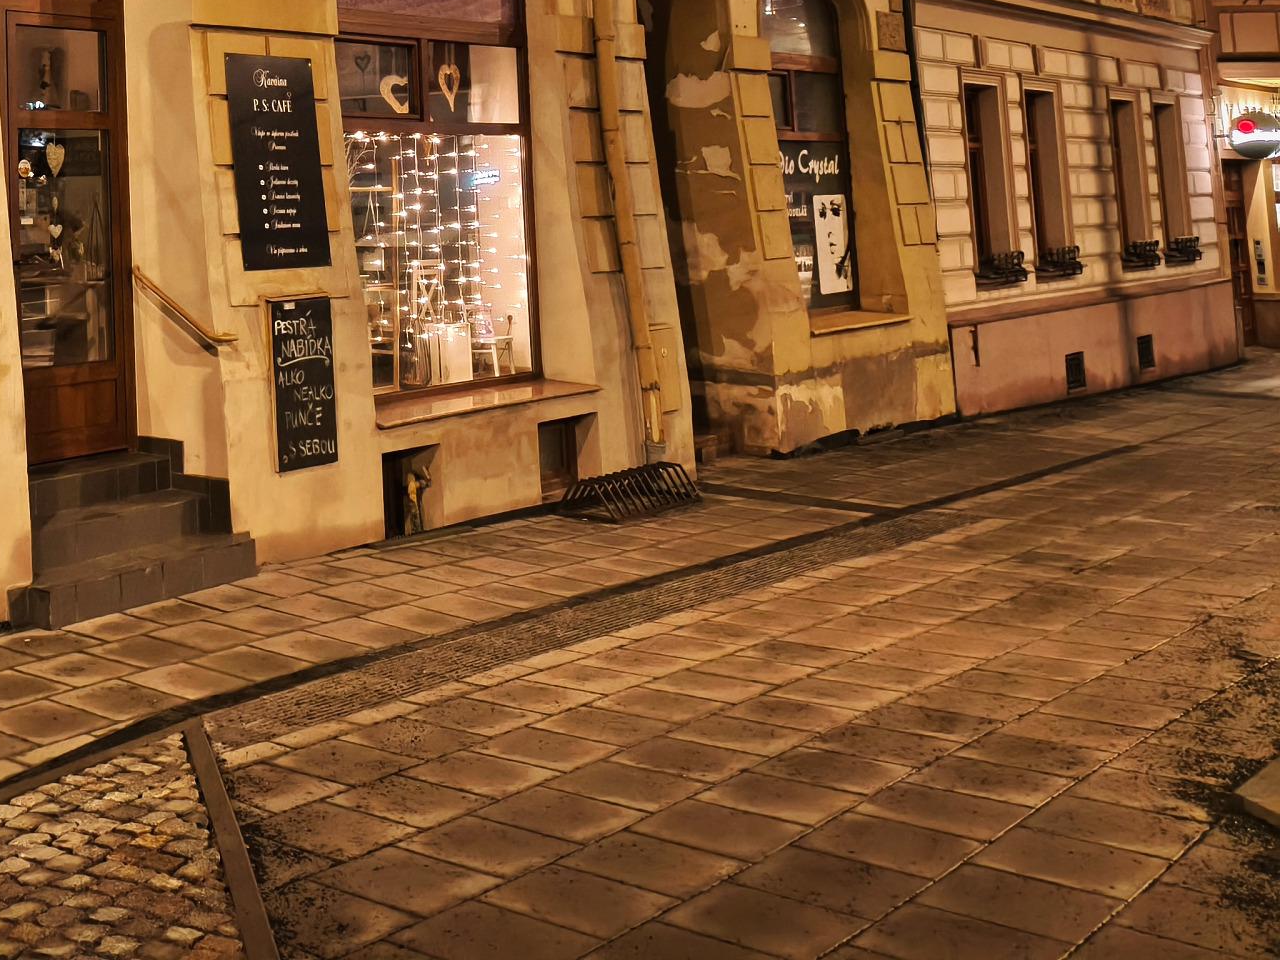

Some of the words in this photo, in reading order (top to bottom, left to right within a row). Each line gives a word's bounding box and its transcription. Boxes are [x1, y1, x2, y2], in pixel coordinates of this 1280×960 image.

[798, 149, 840, 184] Crystal
[274, 310, 317, 338] PESTRÁ
[281, 334, 332, 358] NABÍDKA
[278, 369, 305, 388] ALKO
[294, 384, 334, 401] NEALKO
[284, 401, 323, 430] PUNČE
[299, 438, 335, 457] SEBOU
